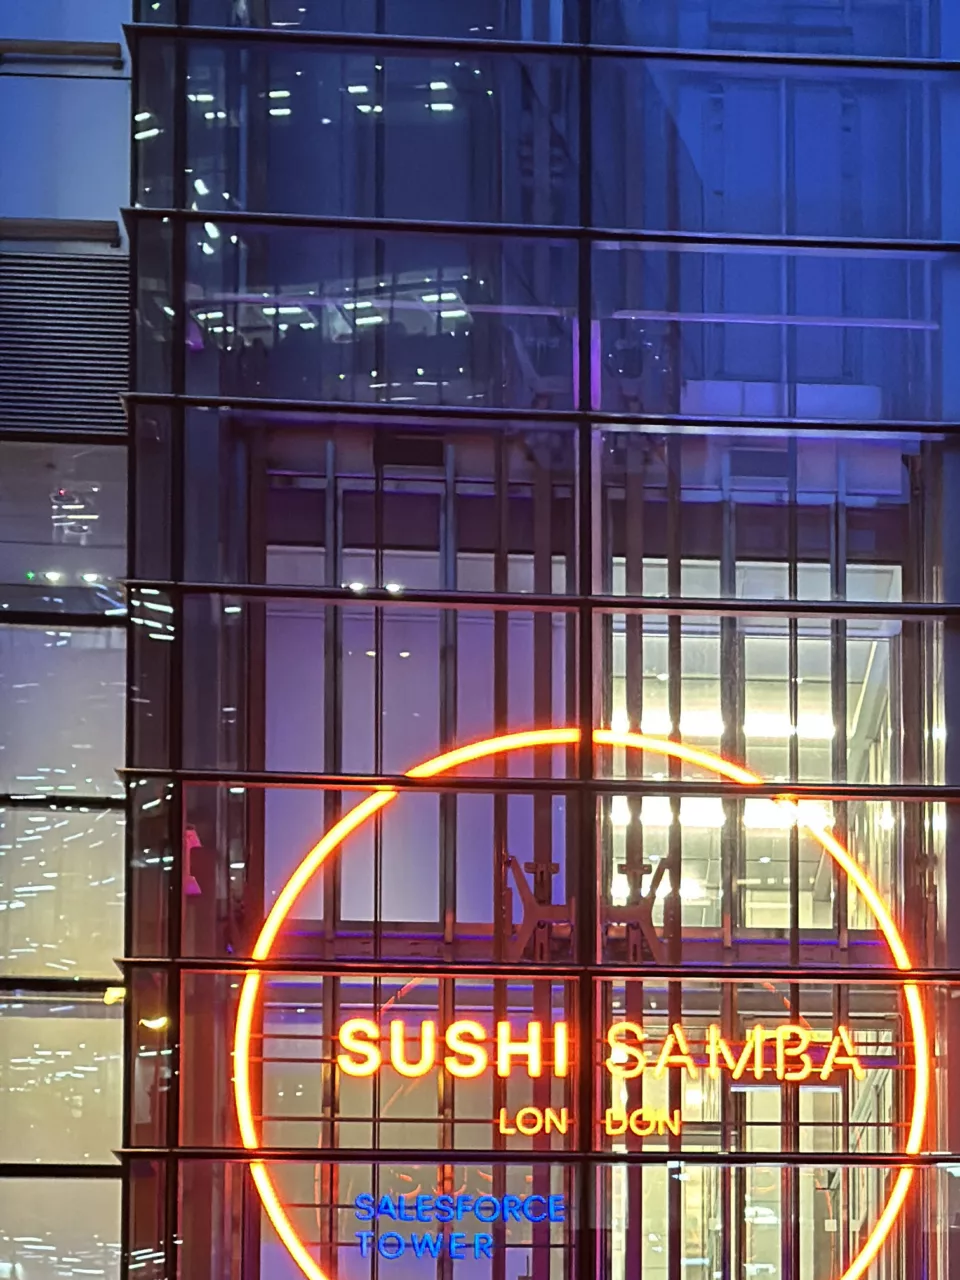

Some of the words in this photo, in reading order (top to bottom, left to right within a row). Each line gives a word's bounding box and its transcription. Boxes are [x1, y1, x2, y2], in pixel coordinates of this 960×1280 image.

[337, 1018, 569, 1079] SUSHI
[605, 1021, 867, 1081] SAMBA
[499, 1107, 569, 1136] LON
[605, 1108, 681, 1136] DON
[355, 1193, 565, 1222] SALESFORCE
[355, 1231, 494, 1259] TOWER
